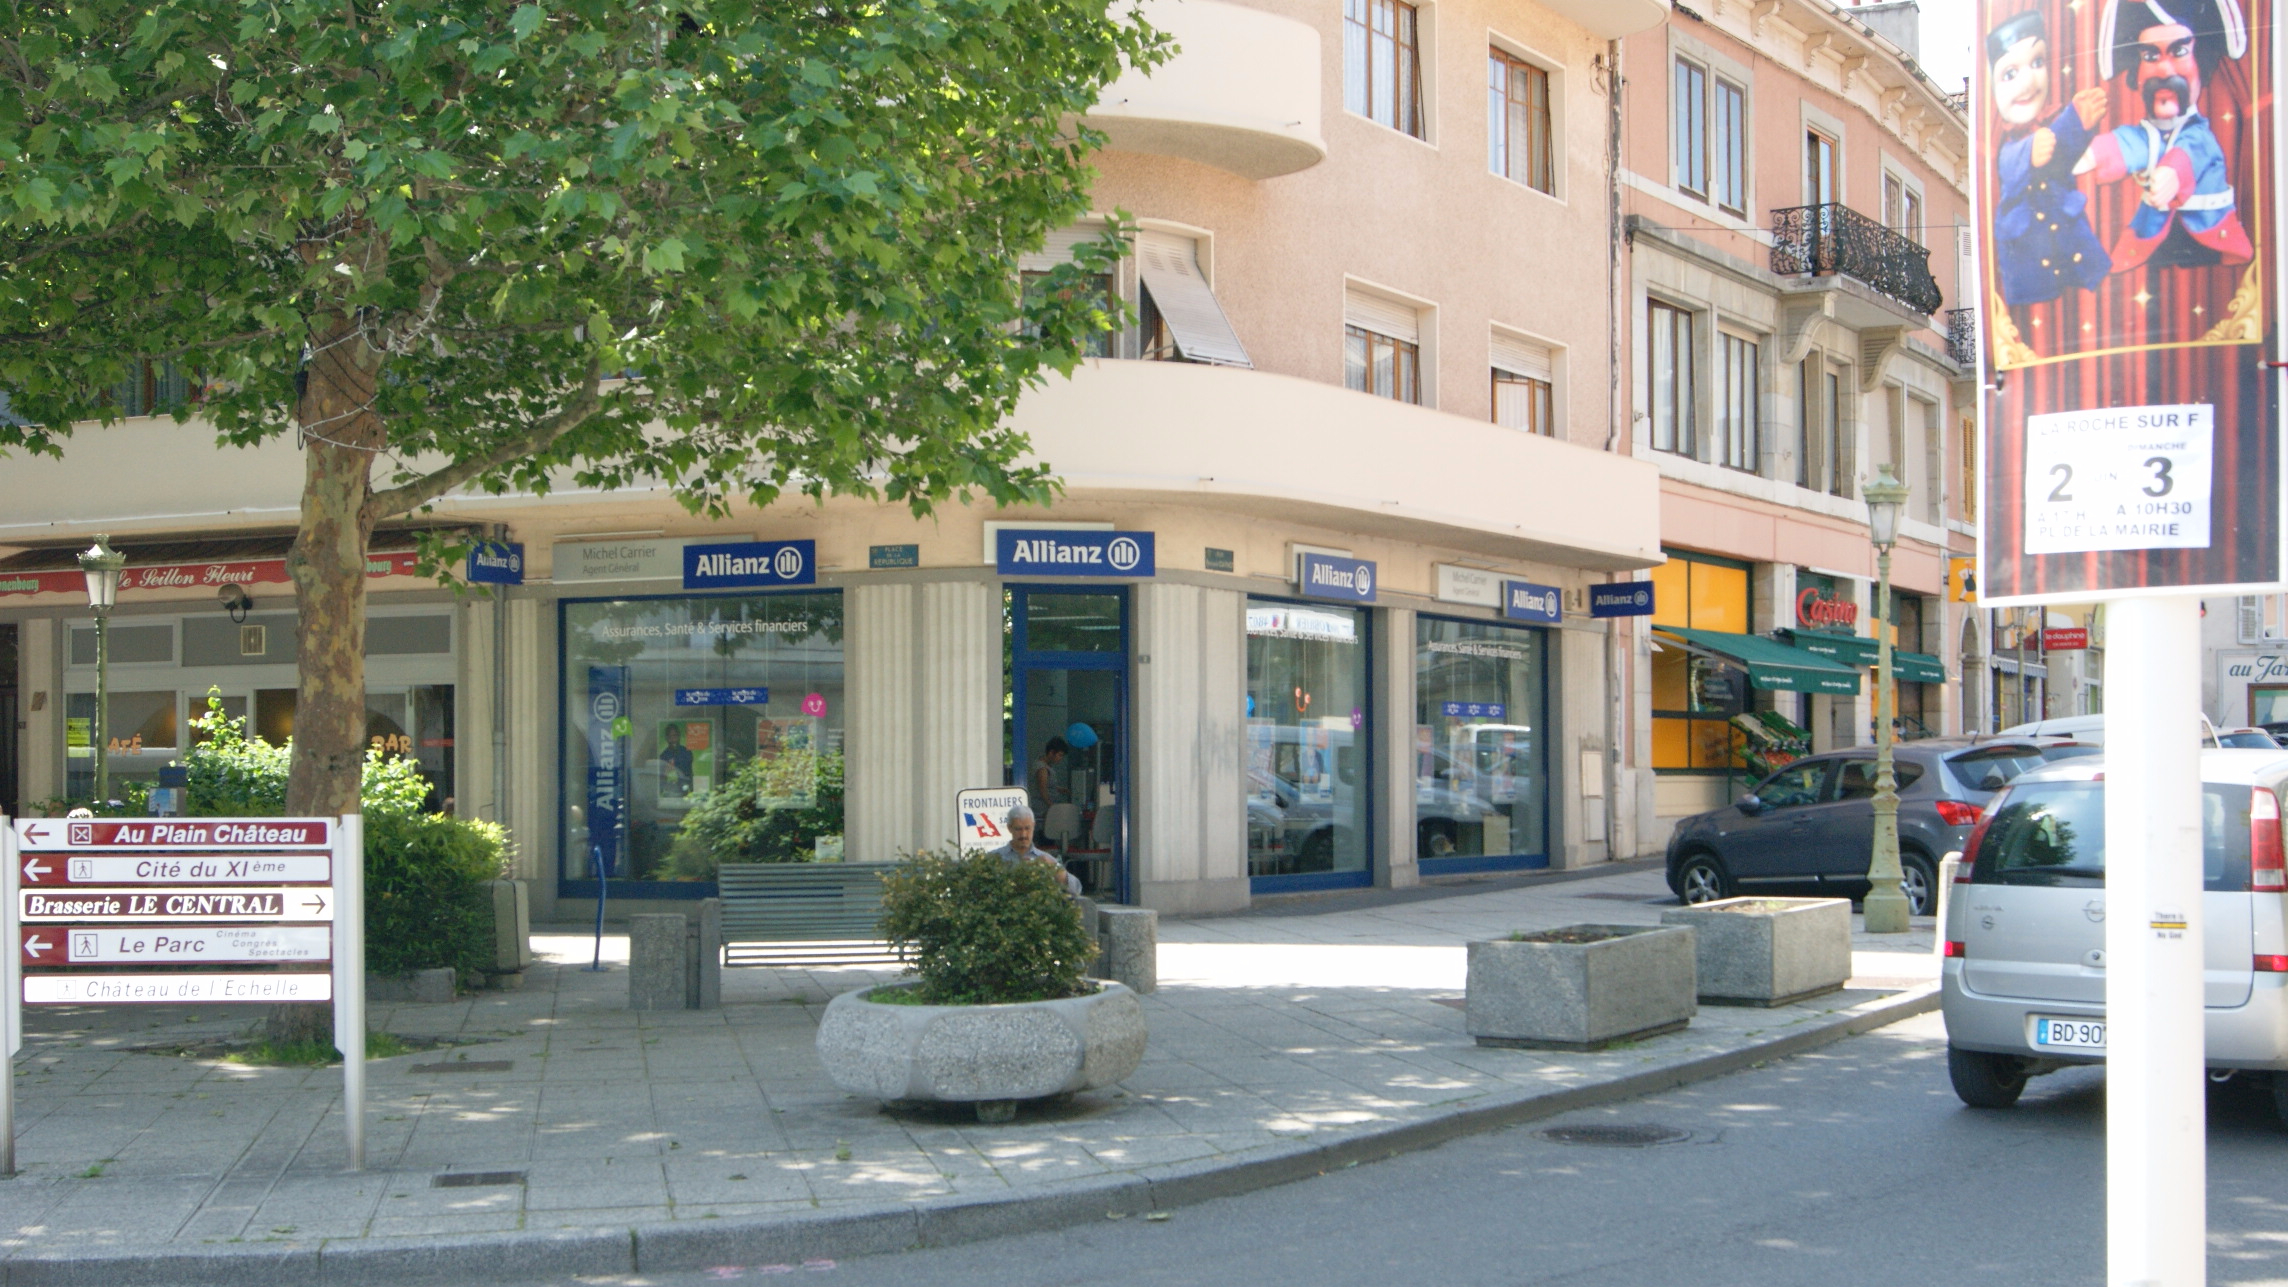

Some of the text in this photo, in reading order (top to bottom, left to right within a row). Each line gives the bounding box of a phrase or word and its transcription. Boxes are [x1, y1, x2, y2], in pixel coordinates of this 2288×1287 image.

[2067, 416, 2129, 433] ROCHE
[2137, 413, 2180, 428] SUR
[2187, 413, 2200, 427] F
[2047, 463, 2074, 502] 2
[2141, 456, 2174, 498] 3
[2116, 502, 2193, 515] A 10H30
[2063, 526, 2081, 536] DE
[2090, 525, 2108, 536] LA
[2115, 523, 2181, 536] MAIRIE
[476, 553, 508, 569] Allianz
[583, 545, 657, 560] Michel Carrier
[1013, 540, 1102, 564] Allianz
[583, 564, 606, 576] Agent
[696, 555, 770, 577] Allianz
[1312, 563, 1354, 588] Allianz
[139, 568, 195, 587] Seillon
[203, 565, 256, 584] Fleuri
[1512, 589, 1545, 611] Allianz
[1595, 594, 1633, 606] Allianz
[1796, 587, 1858, 627] Casino
[602, 618, 808, 637] Assurances, Santé & Services financiers
[2229, 664, 2253, 677] au
[108, 733, 142, 757] AFÉ
[371, 733, 413, 754] BAR
[596, 731, 615, 812] Allianz
[963, 796, 1023, 809] FRONTALIERS
[114, 824, 307, 843] Au Plain Château
[136, 861, 181, 878] Cité
[190, 861, 217, 877] du
[29, 895, 279, 915] Brasserie LE CENTRAL
[216, 930, 257, 938] Cinéma
[119, 936, 205, 953] Le Parc
[232, 939, 278, 949] Congrès
[248, 948, 309, 957] Spectacles
[86, 981, 169, 998] Château
[178, 980, 200, 997] de
[2053, 1023, 2107, 1044] BD-90
